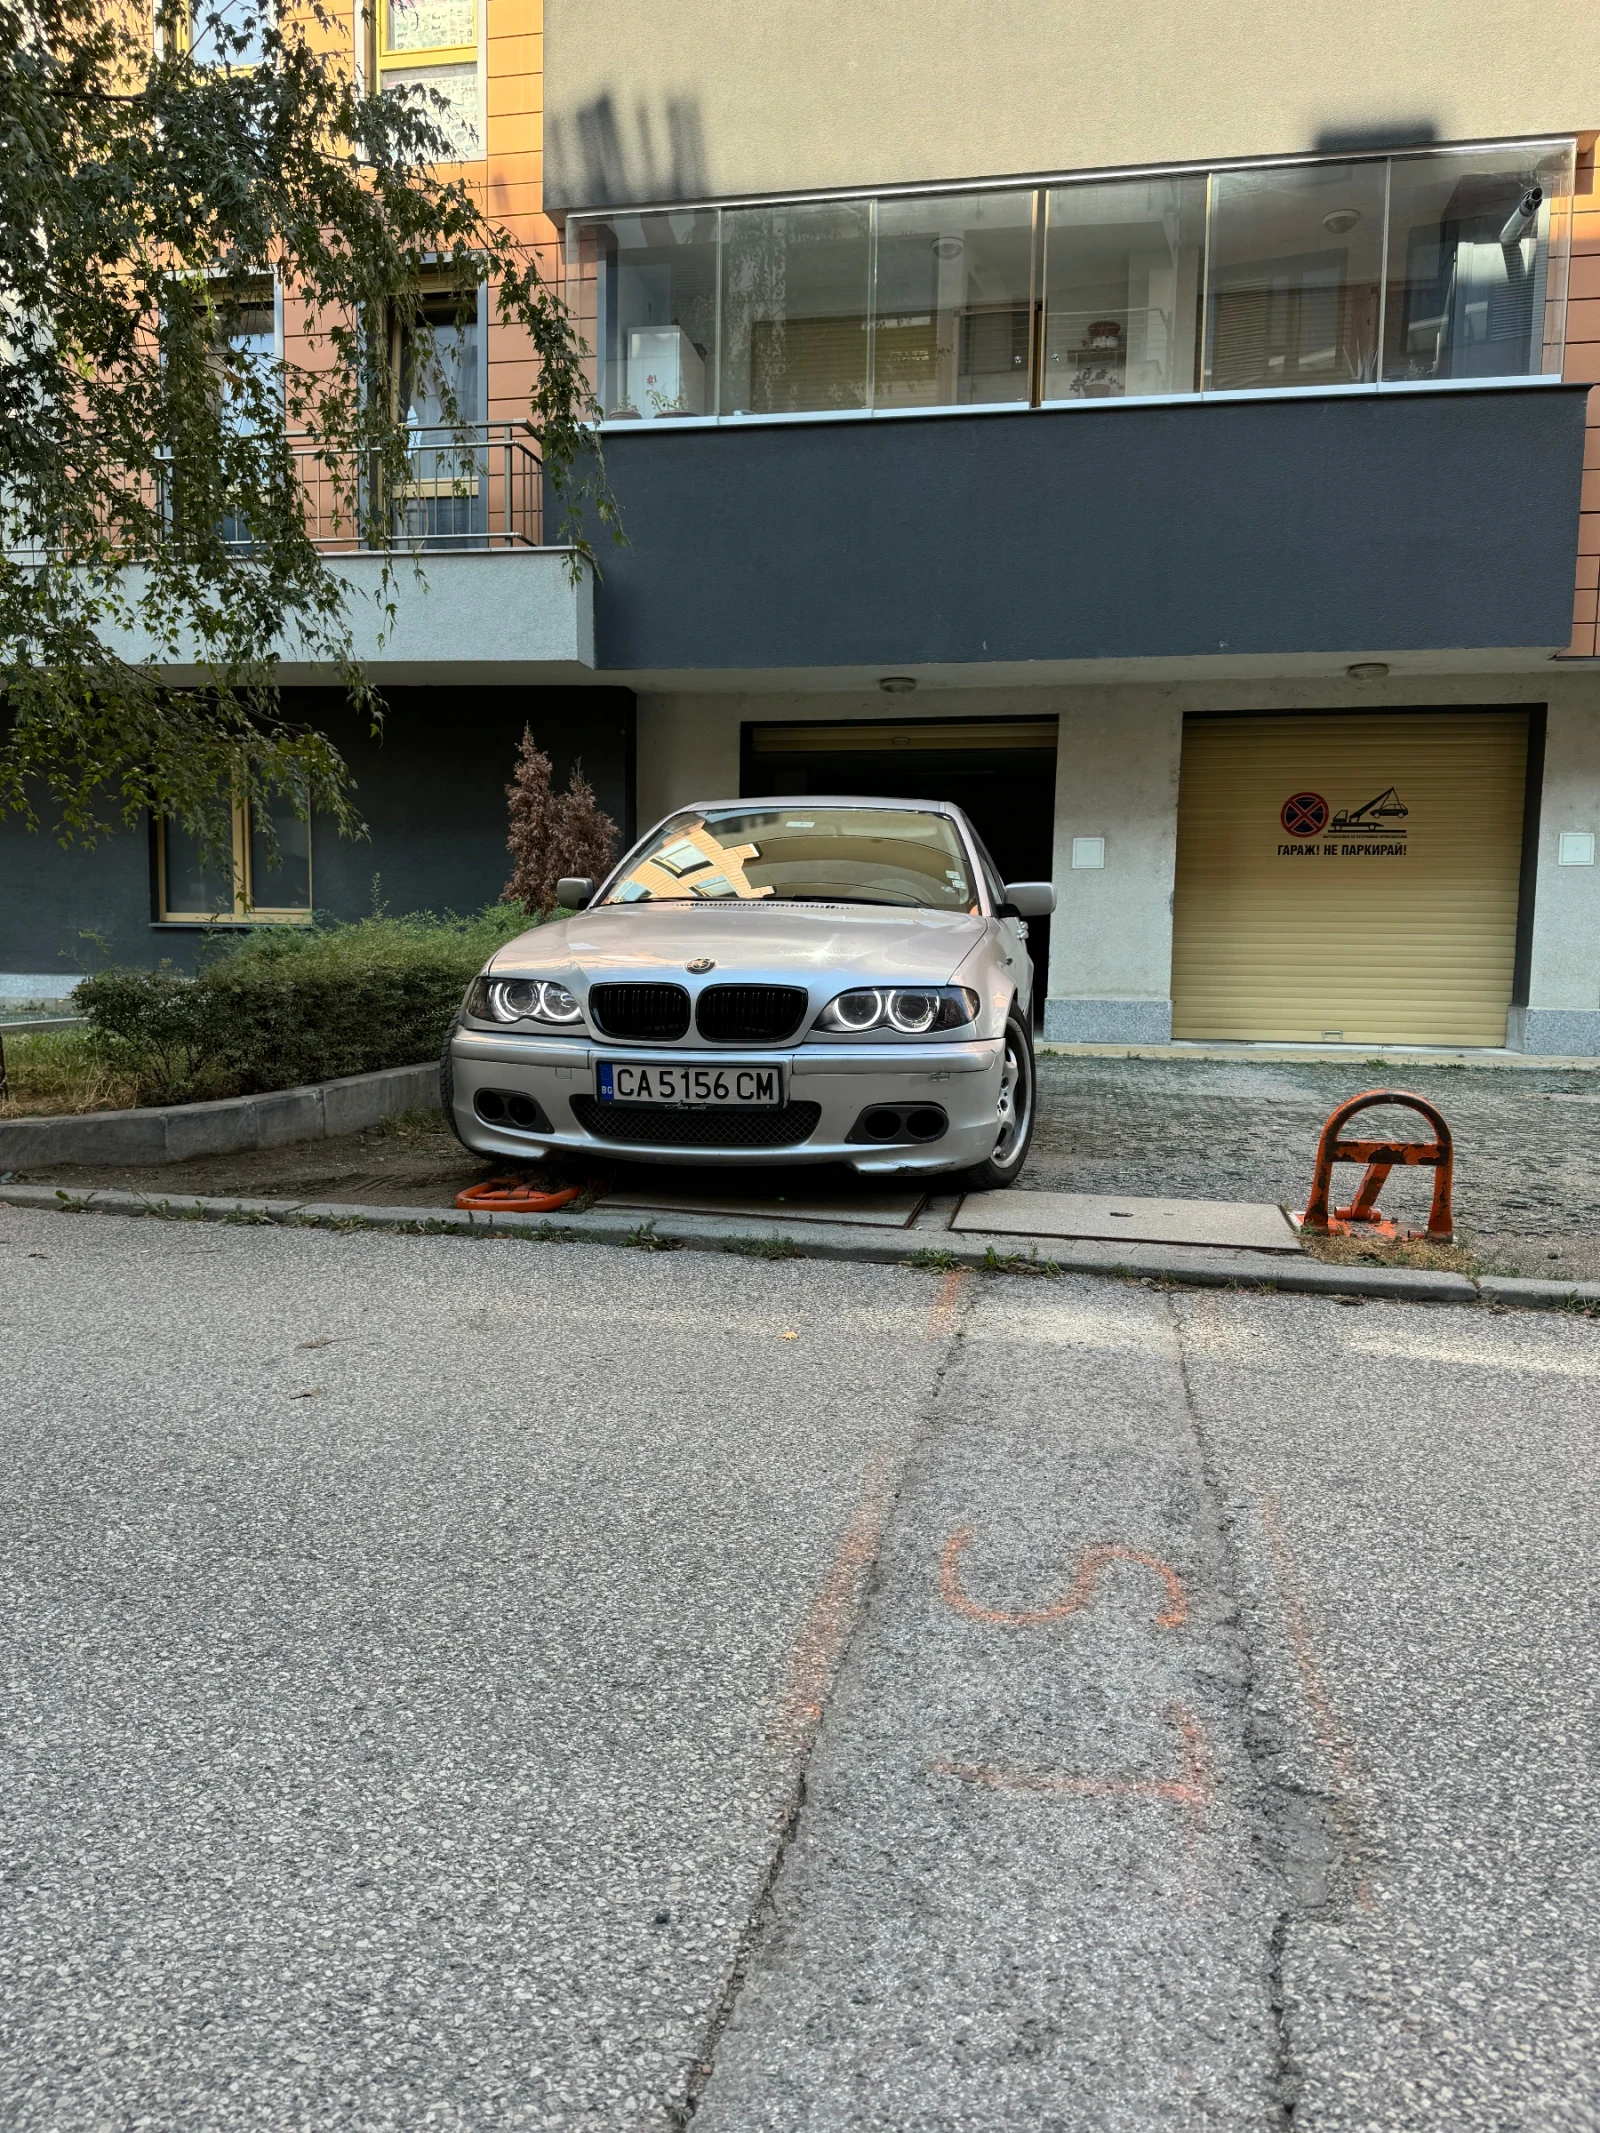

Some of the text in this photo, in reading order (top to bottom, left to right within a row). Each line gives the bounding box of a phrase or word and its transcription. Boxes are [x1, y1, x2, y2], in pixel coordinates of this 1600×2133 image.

[1277, 842, 1407, 856] ГАРАЖ! НЕ ПАРКИРАЙ!
[601, 1085, 613, 1095] BG
[659, 1070, 730, 1100] 5156
